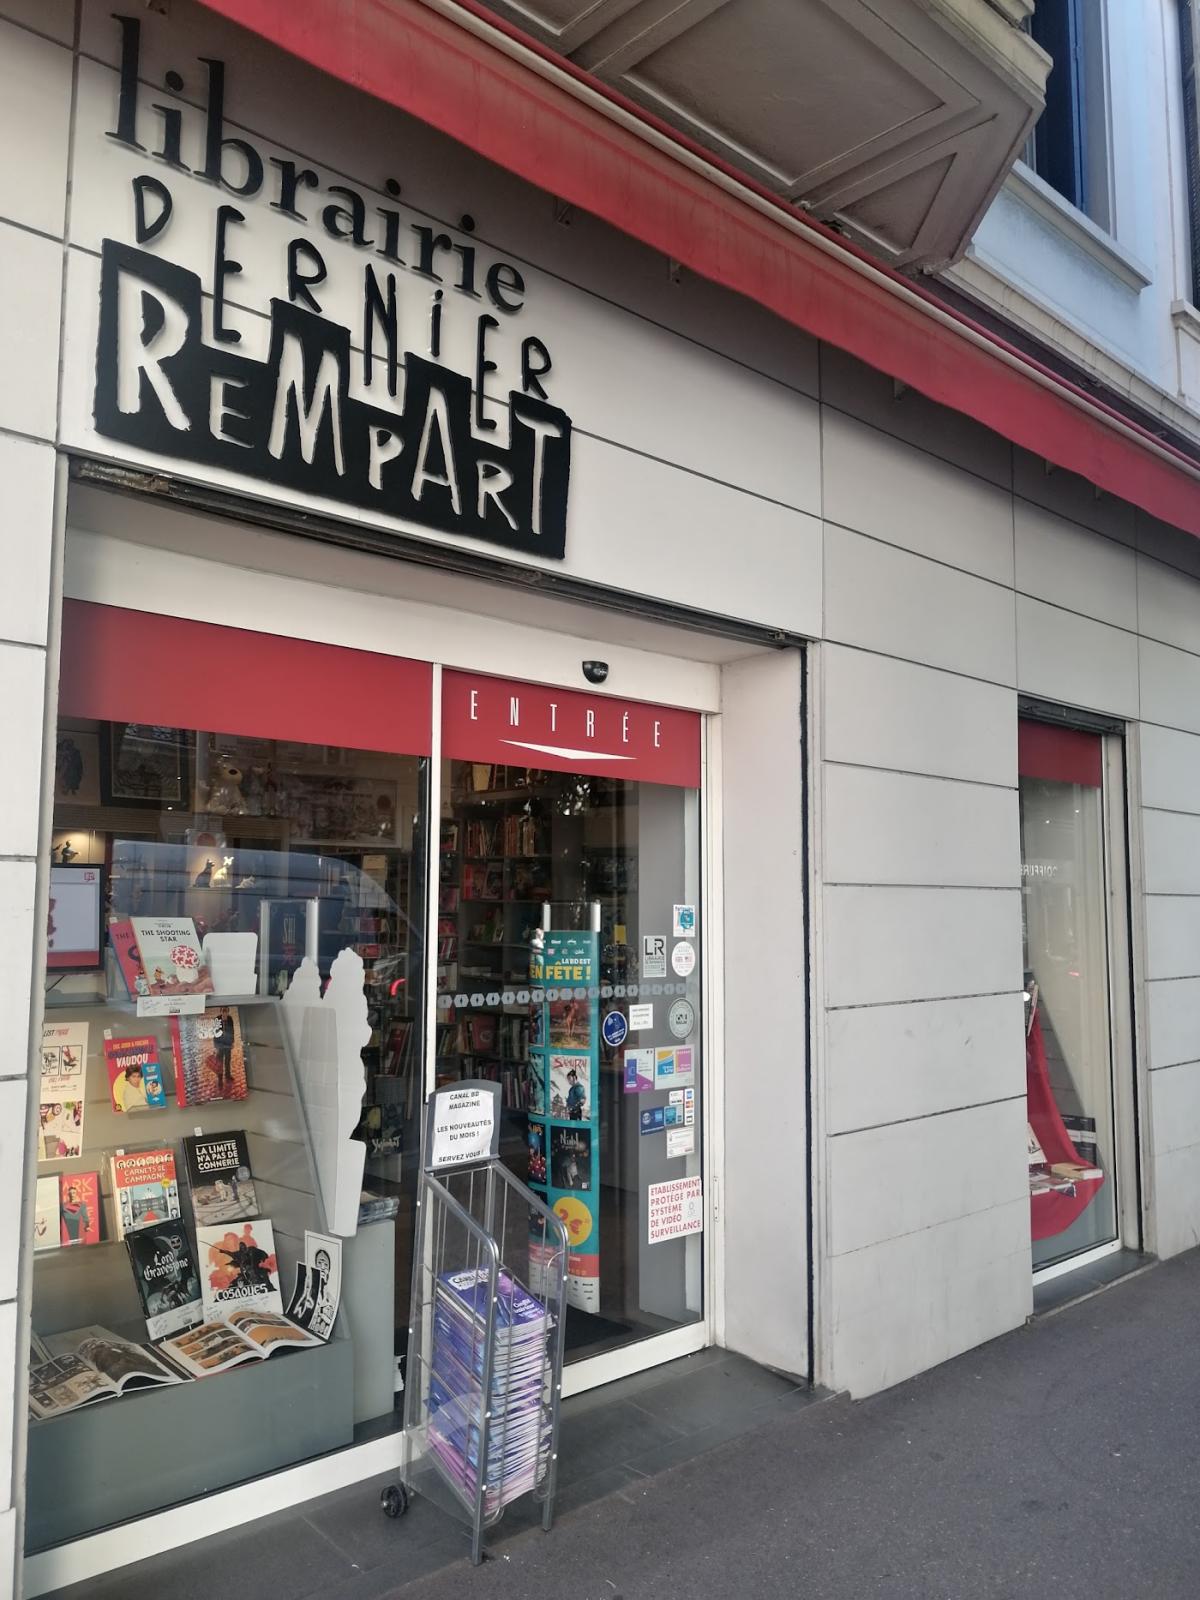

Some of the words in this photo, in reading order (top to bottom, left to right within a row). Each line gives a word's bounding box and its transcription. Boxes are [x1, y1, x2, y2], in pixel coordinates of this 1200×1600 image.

[105, 14, 525, 312] librairie
[116, 264, 563, 536] REMPART
[470, 689, 661, 748] ENTRÉE
[545, 960, 583, 980] FÊTE
[116, 1053, 149, 1068] VAUDOU
[449, 1092, 469, 1101] CANAL
[448, 1100, 481, 1110] MAGAZINE
[437, 1125, 449, 1133] LES
[459, 1131, 476, 1139] MOIS
[195, 1146, 207, 1156] LA
[208, 1142, 238, 1154] LIMITE
[196, 1153, 211, 1163] N'A
[211, 1151, 226, 1160] PAS
[227, 1150, 239, 1159] DE
[439, 1153, 465, 1163] SERVEZ
[198, 1157, 240, 1171] CONNERIE
[124, 1165, 157, 1177] CARNETS
[686, 1189, 700, 1199] PAR
[650, 1219, 659, 1228] DE
[650, 1219, 701, 1239] SURVEILLANCE
[153, 1250, 175, 1267] Lord
